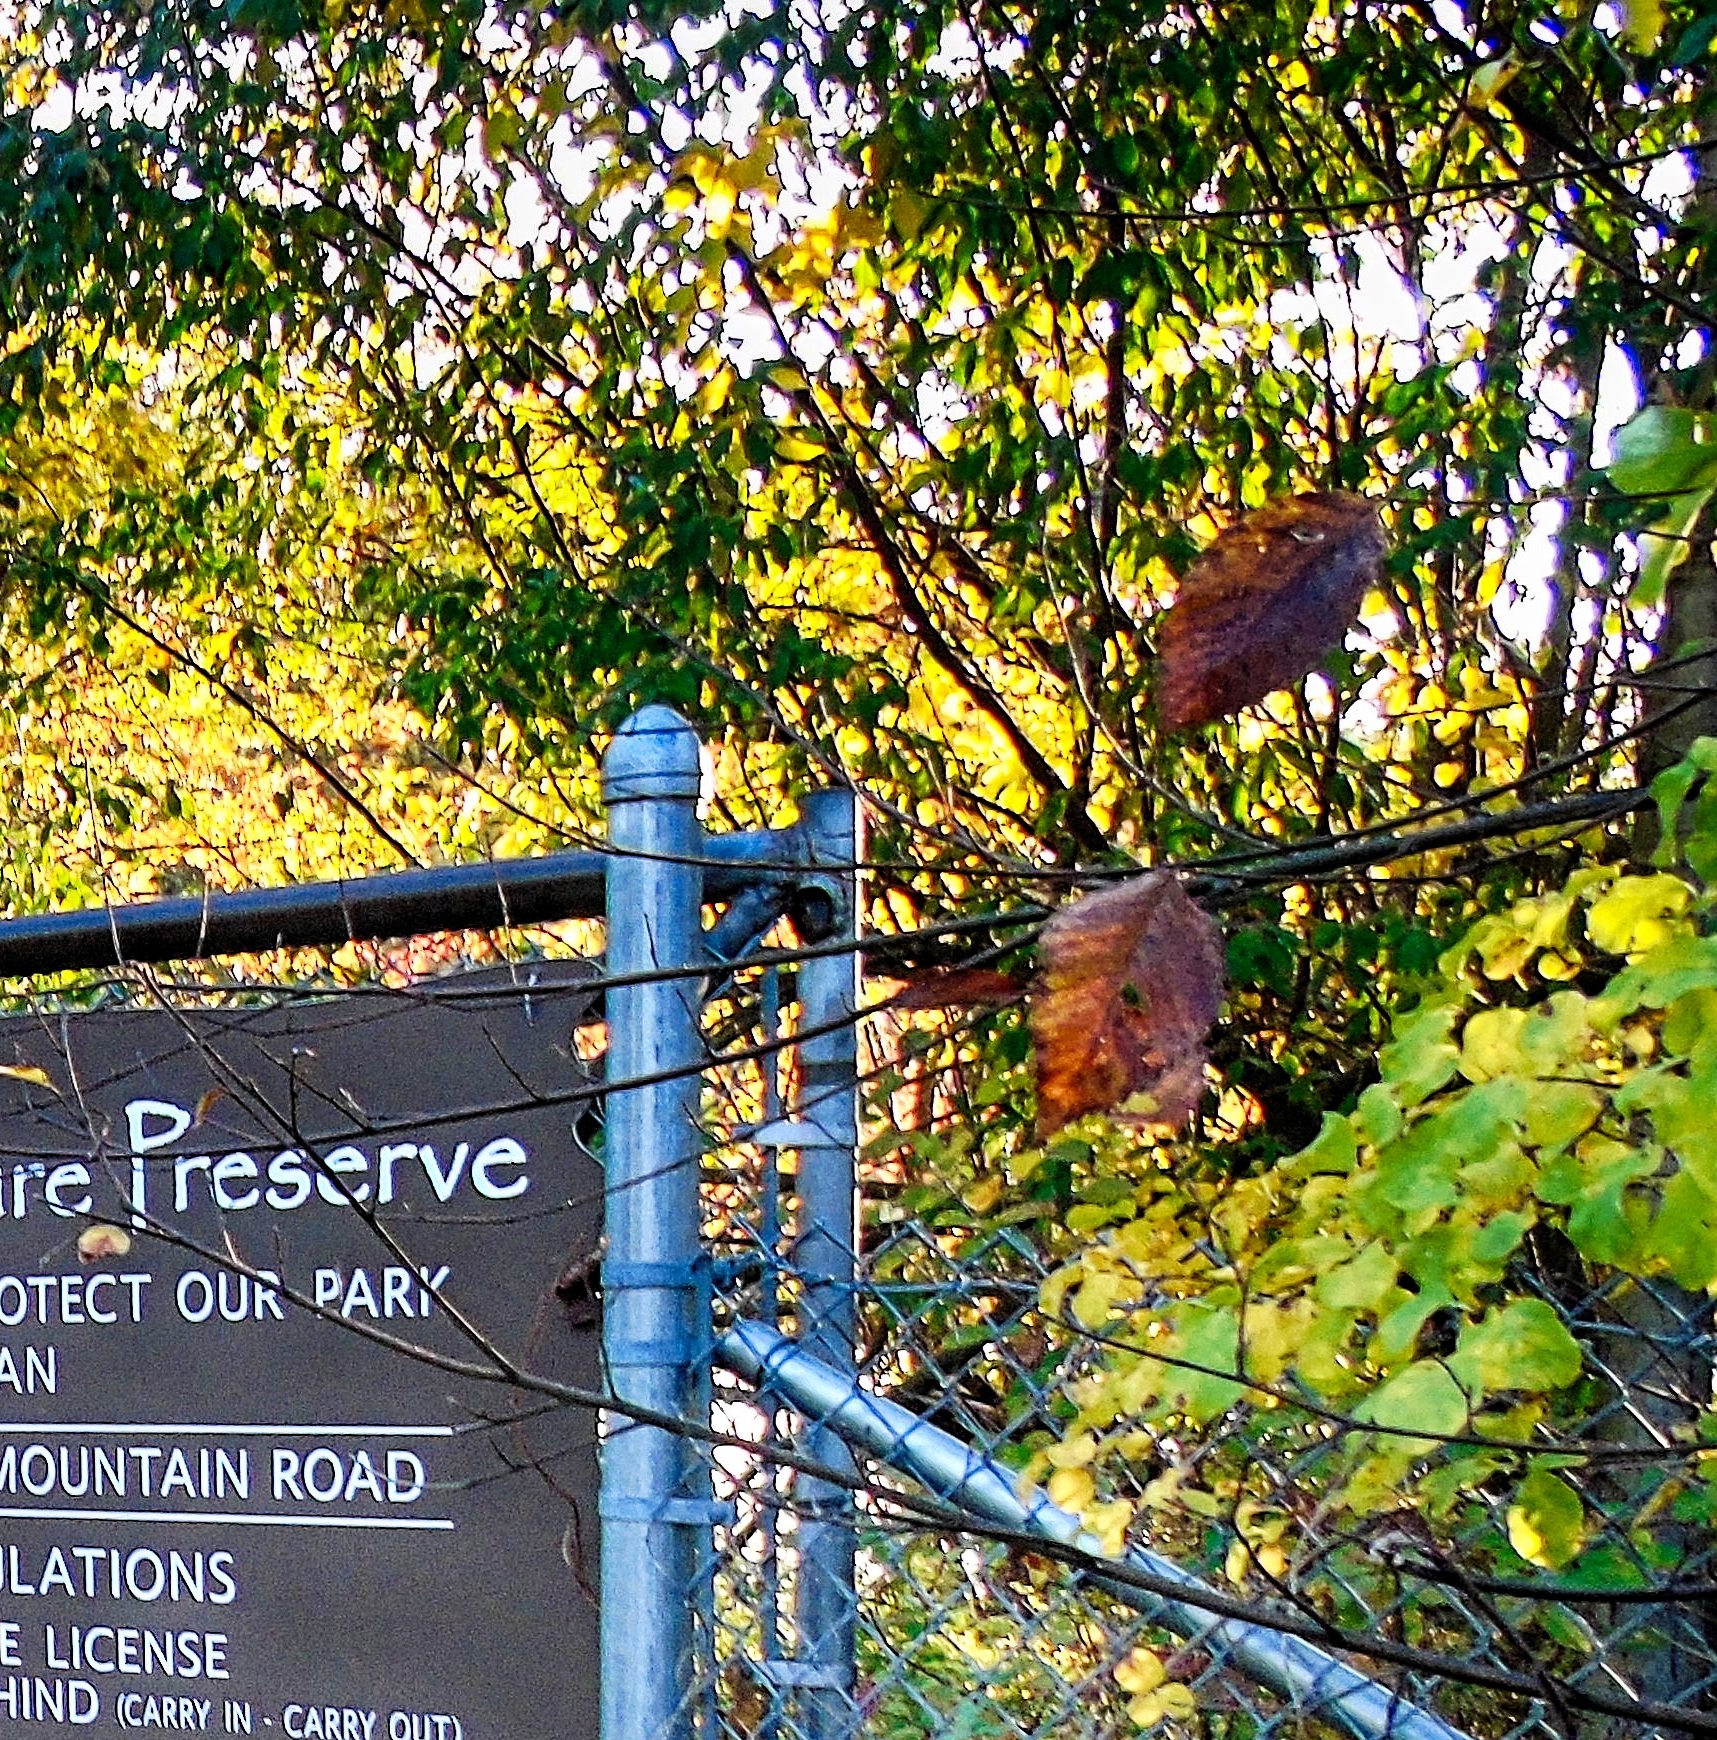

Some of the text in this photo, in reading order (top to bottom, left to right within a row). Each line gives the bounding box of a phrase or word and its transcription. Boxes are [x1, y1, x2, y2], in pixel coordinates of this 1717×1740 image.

[123, 1100, 528, 1234] Preserve
[177, 1271, 284, 1322] OUR
[315, 1266, 452, 1322] PARK
[273, 1449, 425, 1502] ROAD
[47, 1625, 229, 1679] LICENSE
[117, 1693, 211, 1730] (CARRY
[225, 1701, 251, 1734] IN
